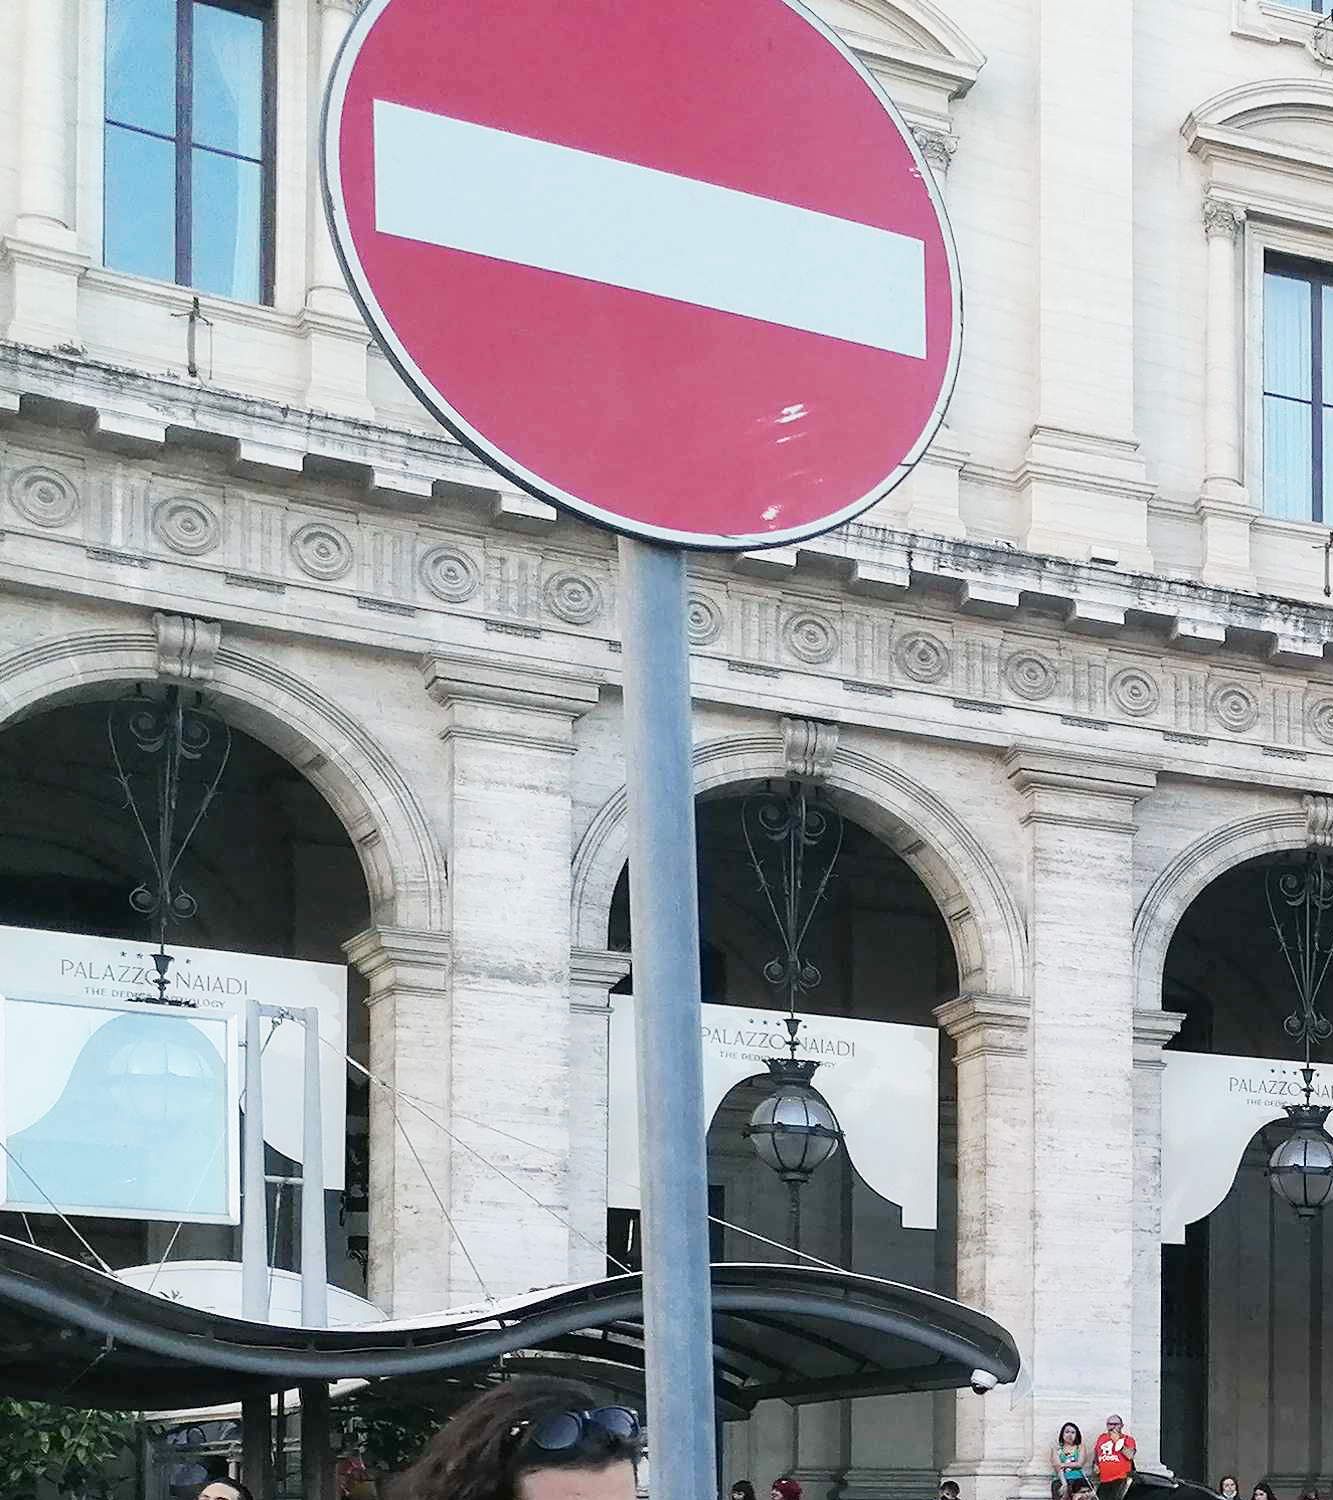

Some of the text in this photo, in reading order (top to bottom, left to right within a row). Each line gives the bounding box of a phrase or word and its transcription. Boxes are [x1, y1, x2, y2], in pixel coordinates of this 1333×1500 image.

[85, 986, 105, 996] THE
[175, 971, 249, 996] NAIADI
[700, 1026, 856, 1058] PALAZZO NAIADI
[1228, 1076, 1302, 1097] PALAZZO
